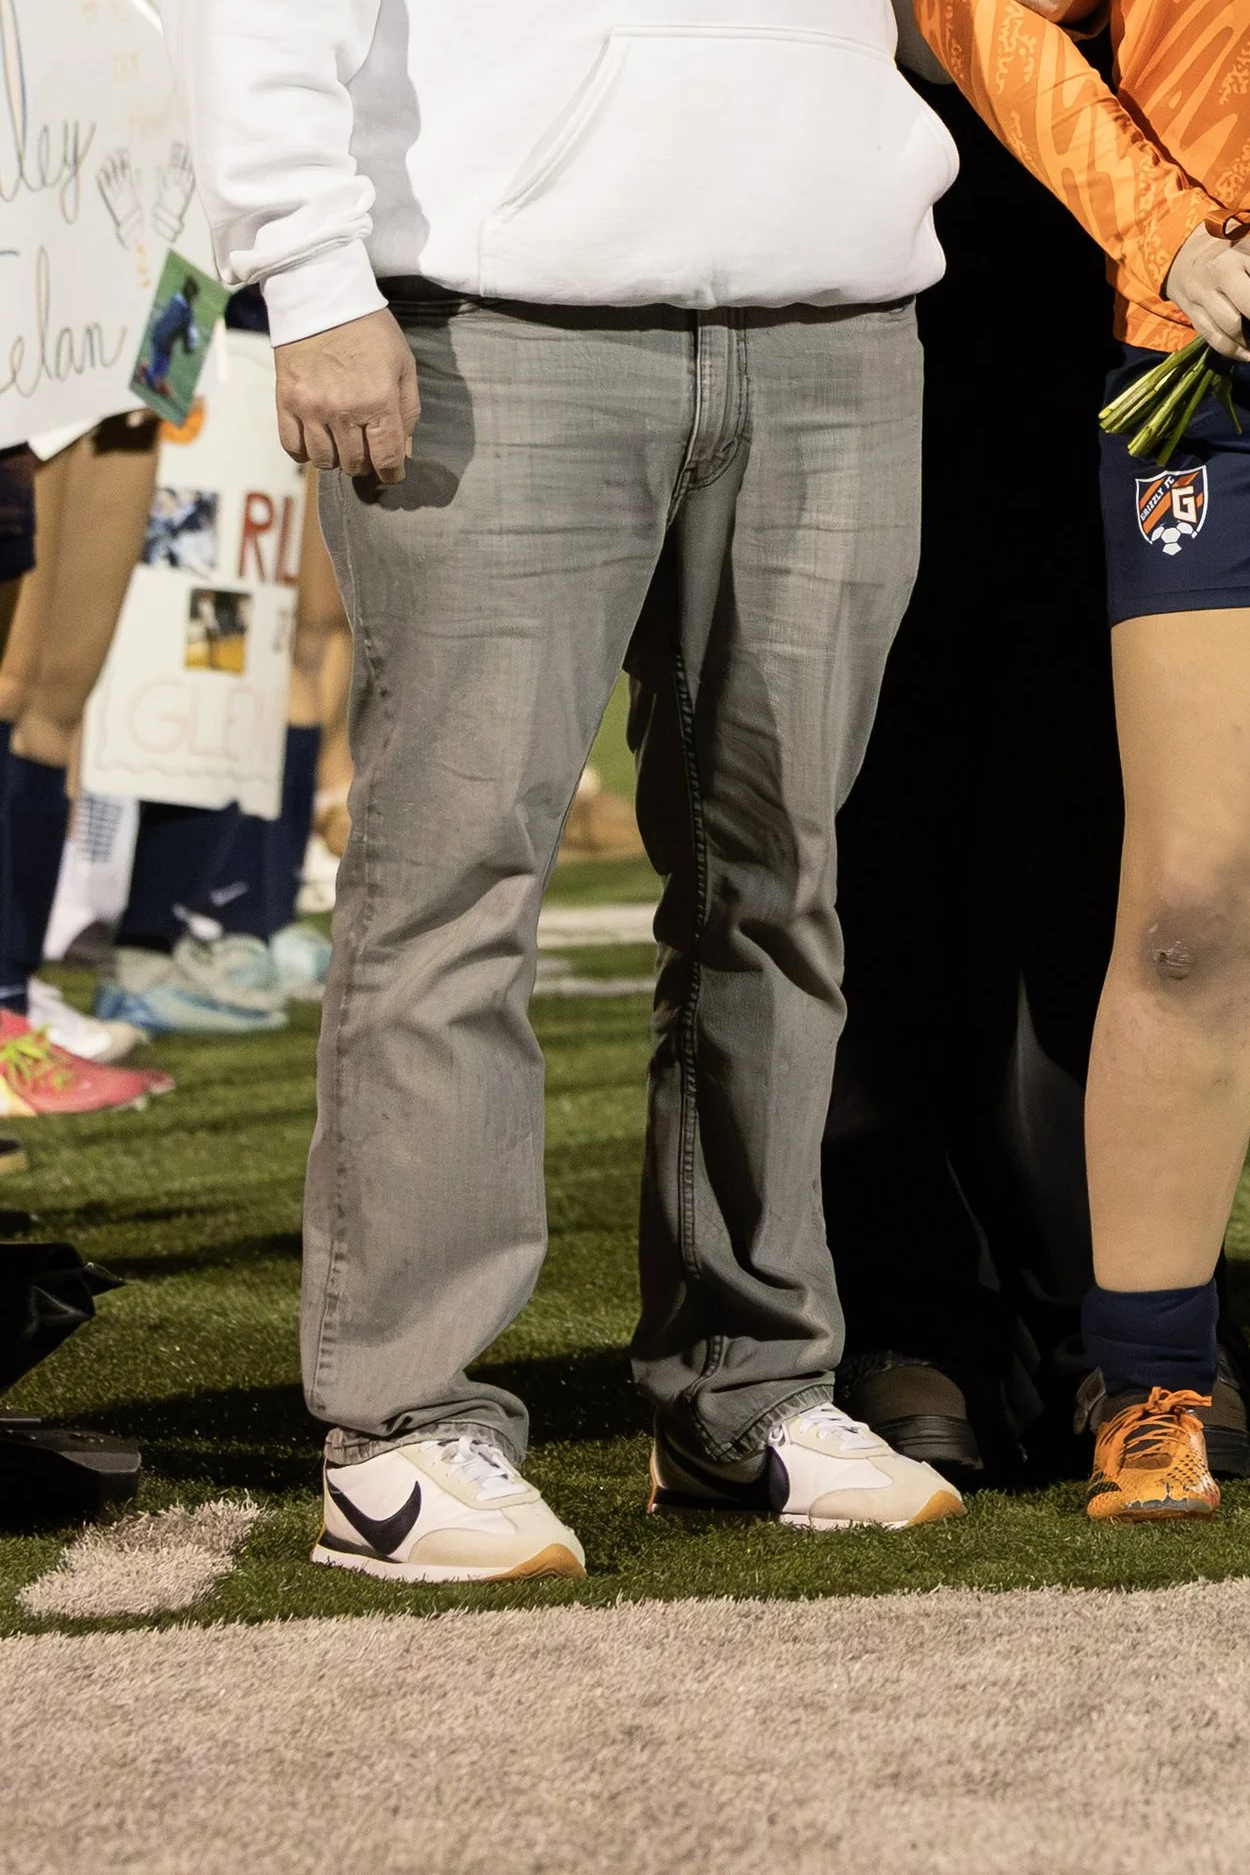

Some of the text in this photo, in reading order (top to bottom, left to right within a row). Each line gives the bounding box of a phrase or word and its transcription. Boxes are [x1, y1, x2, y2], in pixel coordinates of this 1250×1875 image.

[1140, 475, 1175, 522] GRIZZLY FC
[1171, 485, 1198, 524] G
